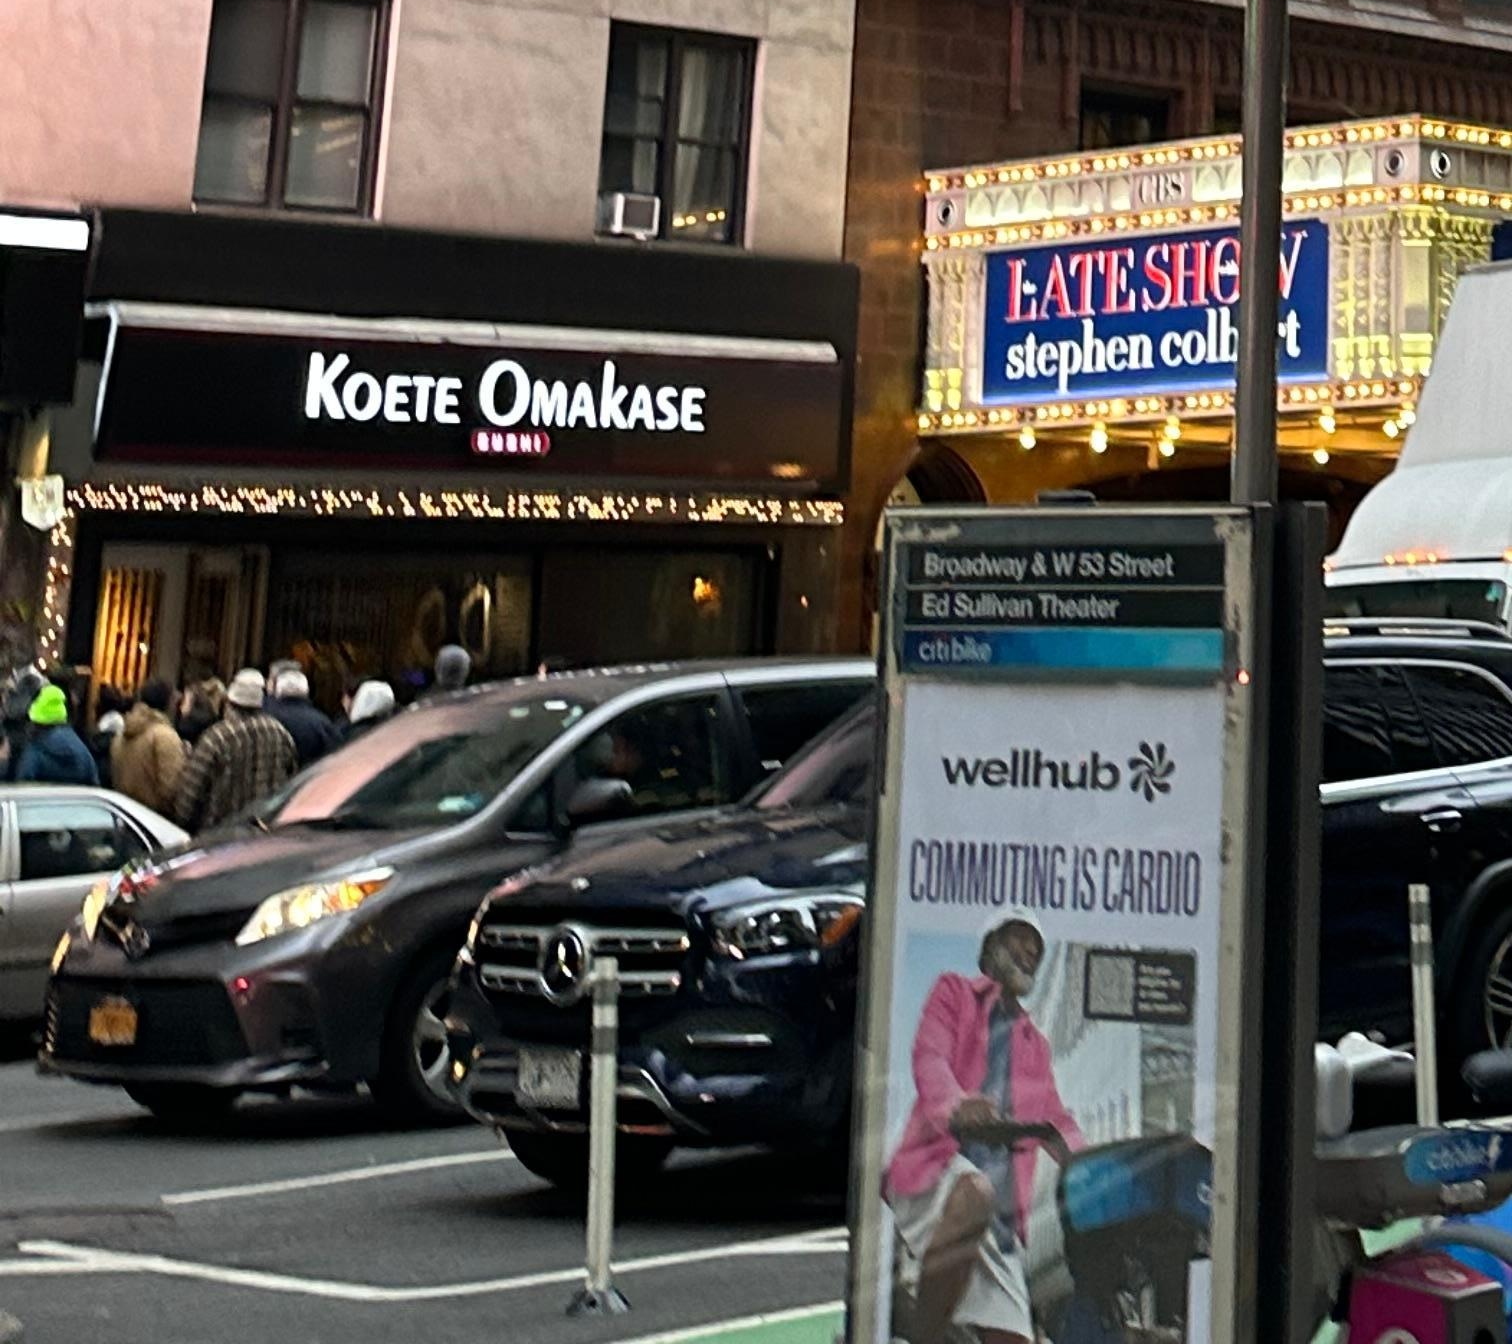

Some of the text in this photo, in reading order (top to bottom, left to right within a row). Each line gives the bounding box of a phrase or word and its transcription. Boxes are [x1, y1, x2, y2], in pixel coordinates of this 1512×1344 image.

[1138, 172, 1186, 204] CBS
[1005, 247, 1136, 324] LATE
[1005, 317, 1155, 396] stephen
[923, 551, 1176, 581] Broadway & W 53 Street
[922, 592, 1120, 620] Ed Sullivan Theater
[941, 747, 1121, 792] wellhub
[908, 837, 1202, 917] COMMUTING IS CARDIO
